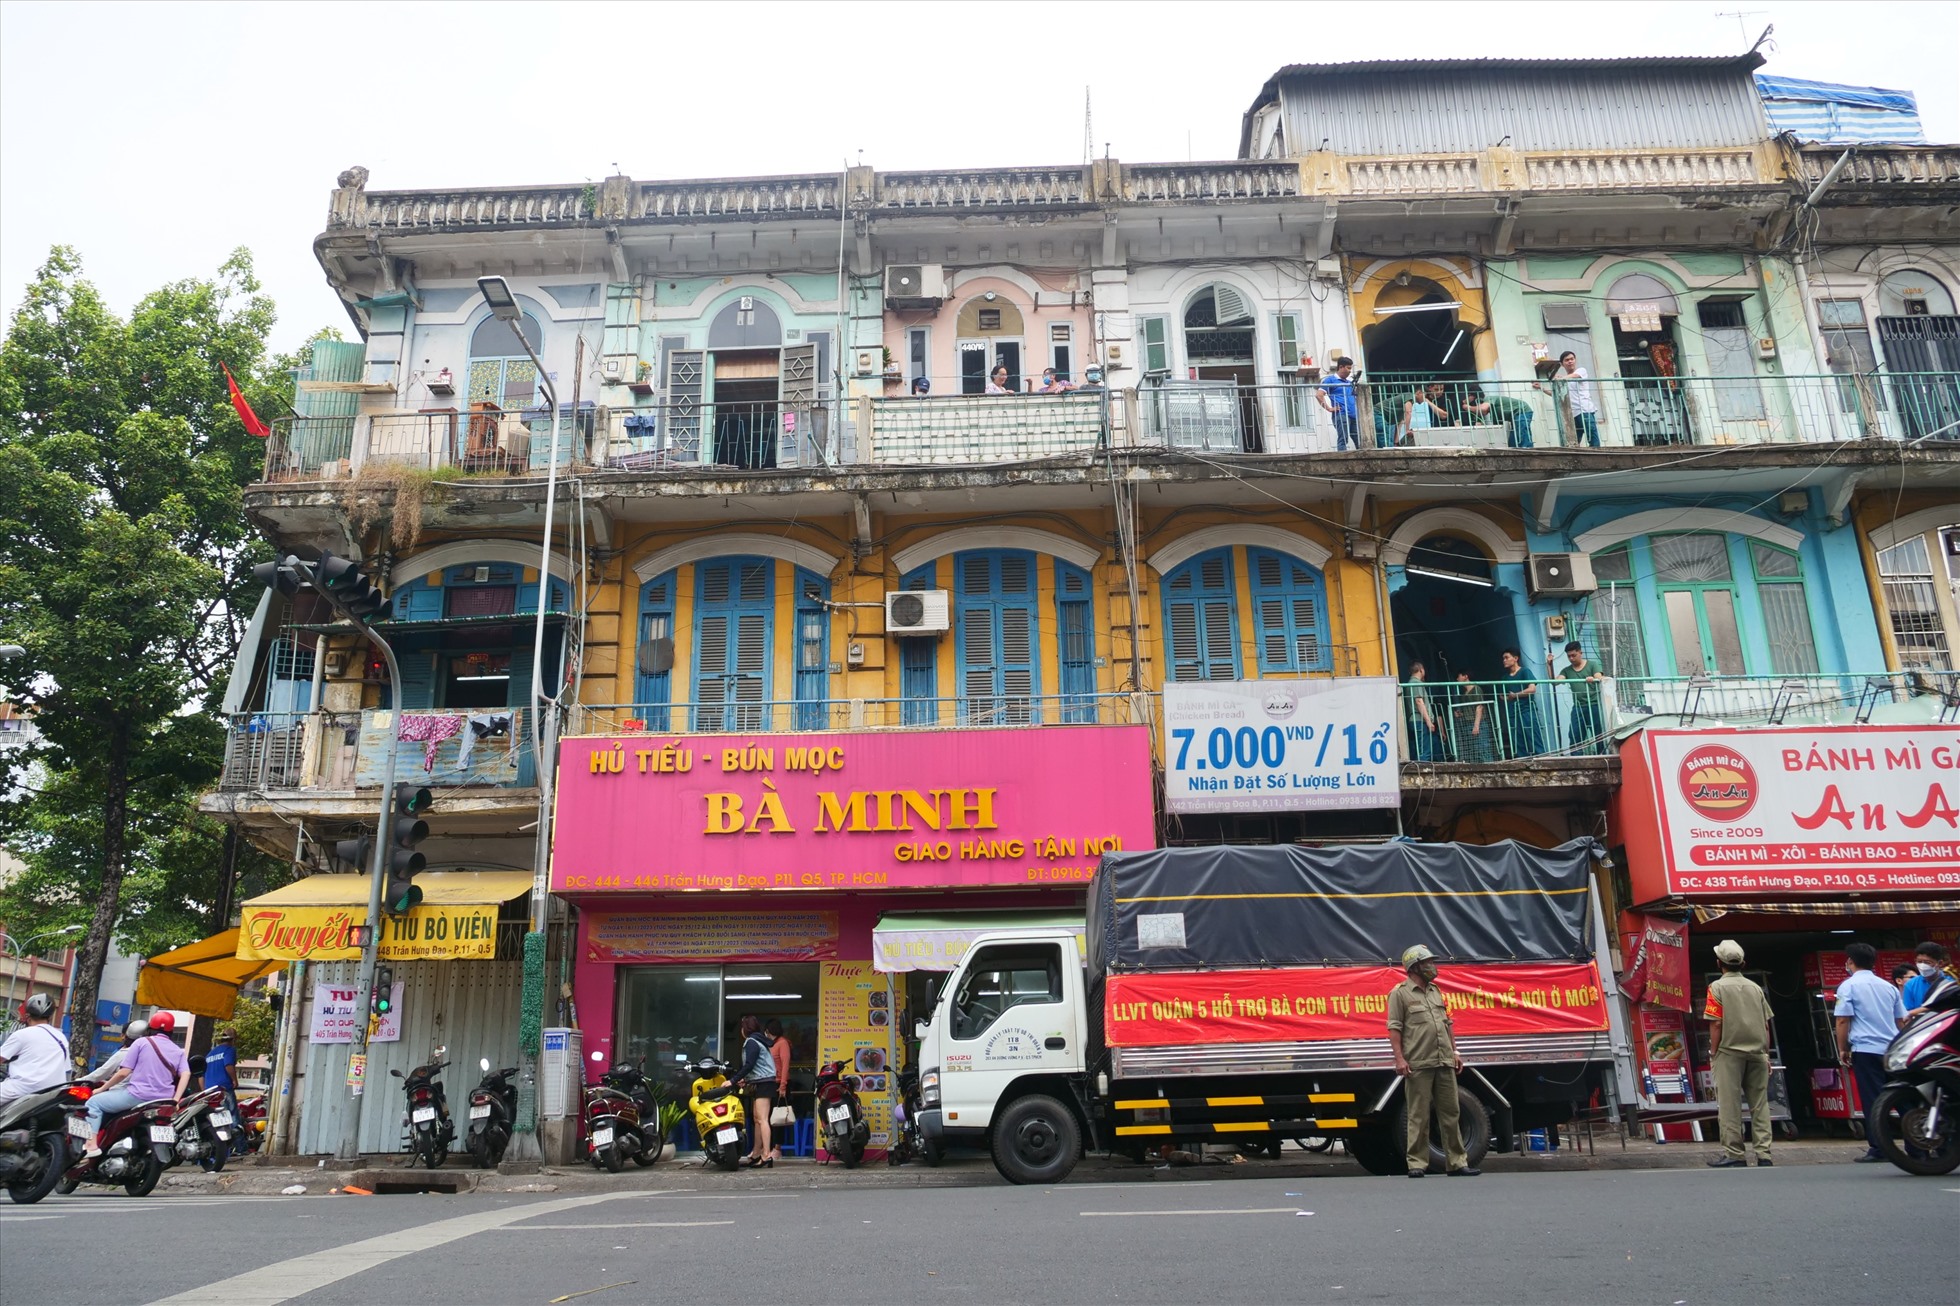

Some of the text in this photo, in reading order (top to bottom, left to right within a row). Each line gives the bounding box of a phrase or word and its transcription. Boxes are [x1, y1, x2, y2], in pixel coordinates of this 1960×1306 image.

[590, 740, 844, 775] HỦ TIẾU BÚN MỌC
[1686, 755, 1745, 771] BÁNH MÌ GÀ
[1782, 741, 1875, 772] BÁNH
[1884, 740, 1921, 770] MÌ
[1188, 772, 1375, 793] Nhận Đặt Số Lượng Lớn
[1692, 784, 1749, 799] An An
[703, 776, 998, 834] BÀ MINH
[1306, 796, 1338, 807] Hotline:
[1339, 796, 1361, 806] 0938
[1362, 795, 1377, 805] 688
[1792, 784, 1887, 831] An
[1690, 827, 1763, 839] Since 2009
[895, 842, 952, 862] GIAO
[960, 835, 1025, 860] HÀNG
[1033, 835, 1076, 860] TẬN
[1705, 848, 1747, 861] BÁNH
[1751, 847, 1768, 860] MÌ
[1781, 846, 1806, 859] XÔI
[1821, 845, 1863, 859] BÁNH
[1866, 848, 1897, 858] BAO
[1911, 844, 1953, 858] BÁNH
[566, 872, 887, 889] ĐC: 444 446 Trần Hưng Đạo, P11, Q5, TP. HCM
[1027, 869, 1048, 880] ĐT:
[1051, 868, 1081, 879] 0916
[1680, 877, 1702, 888] ĐC:
[1705, 877, 1726, 887] 438
[1729, 875, 1756, 887] Trần
[1759, 875, 1791, 889] Hưng
[1794, 874, 1822, 888] Đạo,
[1824, 874, 1852, 887] P.10,
[1856, 874, 1876, 886] Q.5
[1888, 873, 1935, 885] Hotline:
[248, 910, 354, 958] Tuyết
[424, 911, 451, 940] BÒ
[454, 911, 492, 939] VIÊN
[411, 945, 430, 956] Hưng
[432, 946, 446, 956] Đạo
[454, 945, 470, 954] P.11
[478, 944, 491, 954] Q.5
[883, 938, 900, 957] HỦ
[906, 936, 933, 956] TIẾU
[1674, 986, 1683, 997] GÀ
[1112, 1002, 1148, 1021] LLVT
[1152, 997, 1193, 1022] QUẬN
[1199, 1000, 1206, 1019] 5
[1212, 993, 1233, 1018] HỖ
[1237, 996, 1267, 1020] TRỢ
[1271, 993, 1292, 1016] BÀ
[1296, 996, 1326, 1015] CON
[1330, 993, 1350, 1018] TỰ
[1497, 986, 1519, 1008] VỀ
[1522, 988, 1546, 1008] NƠI
[1551, 984, 1562, 1008] Ở
[354, 1066, 362, 1076] 5
